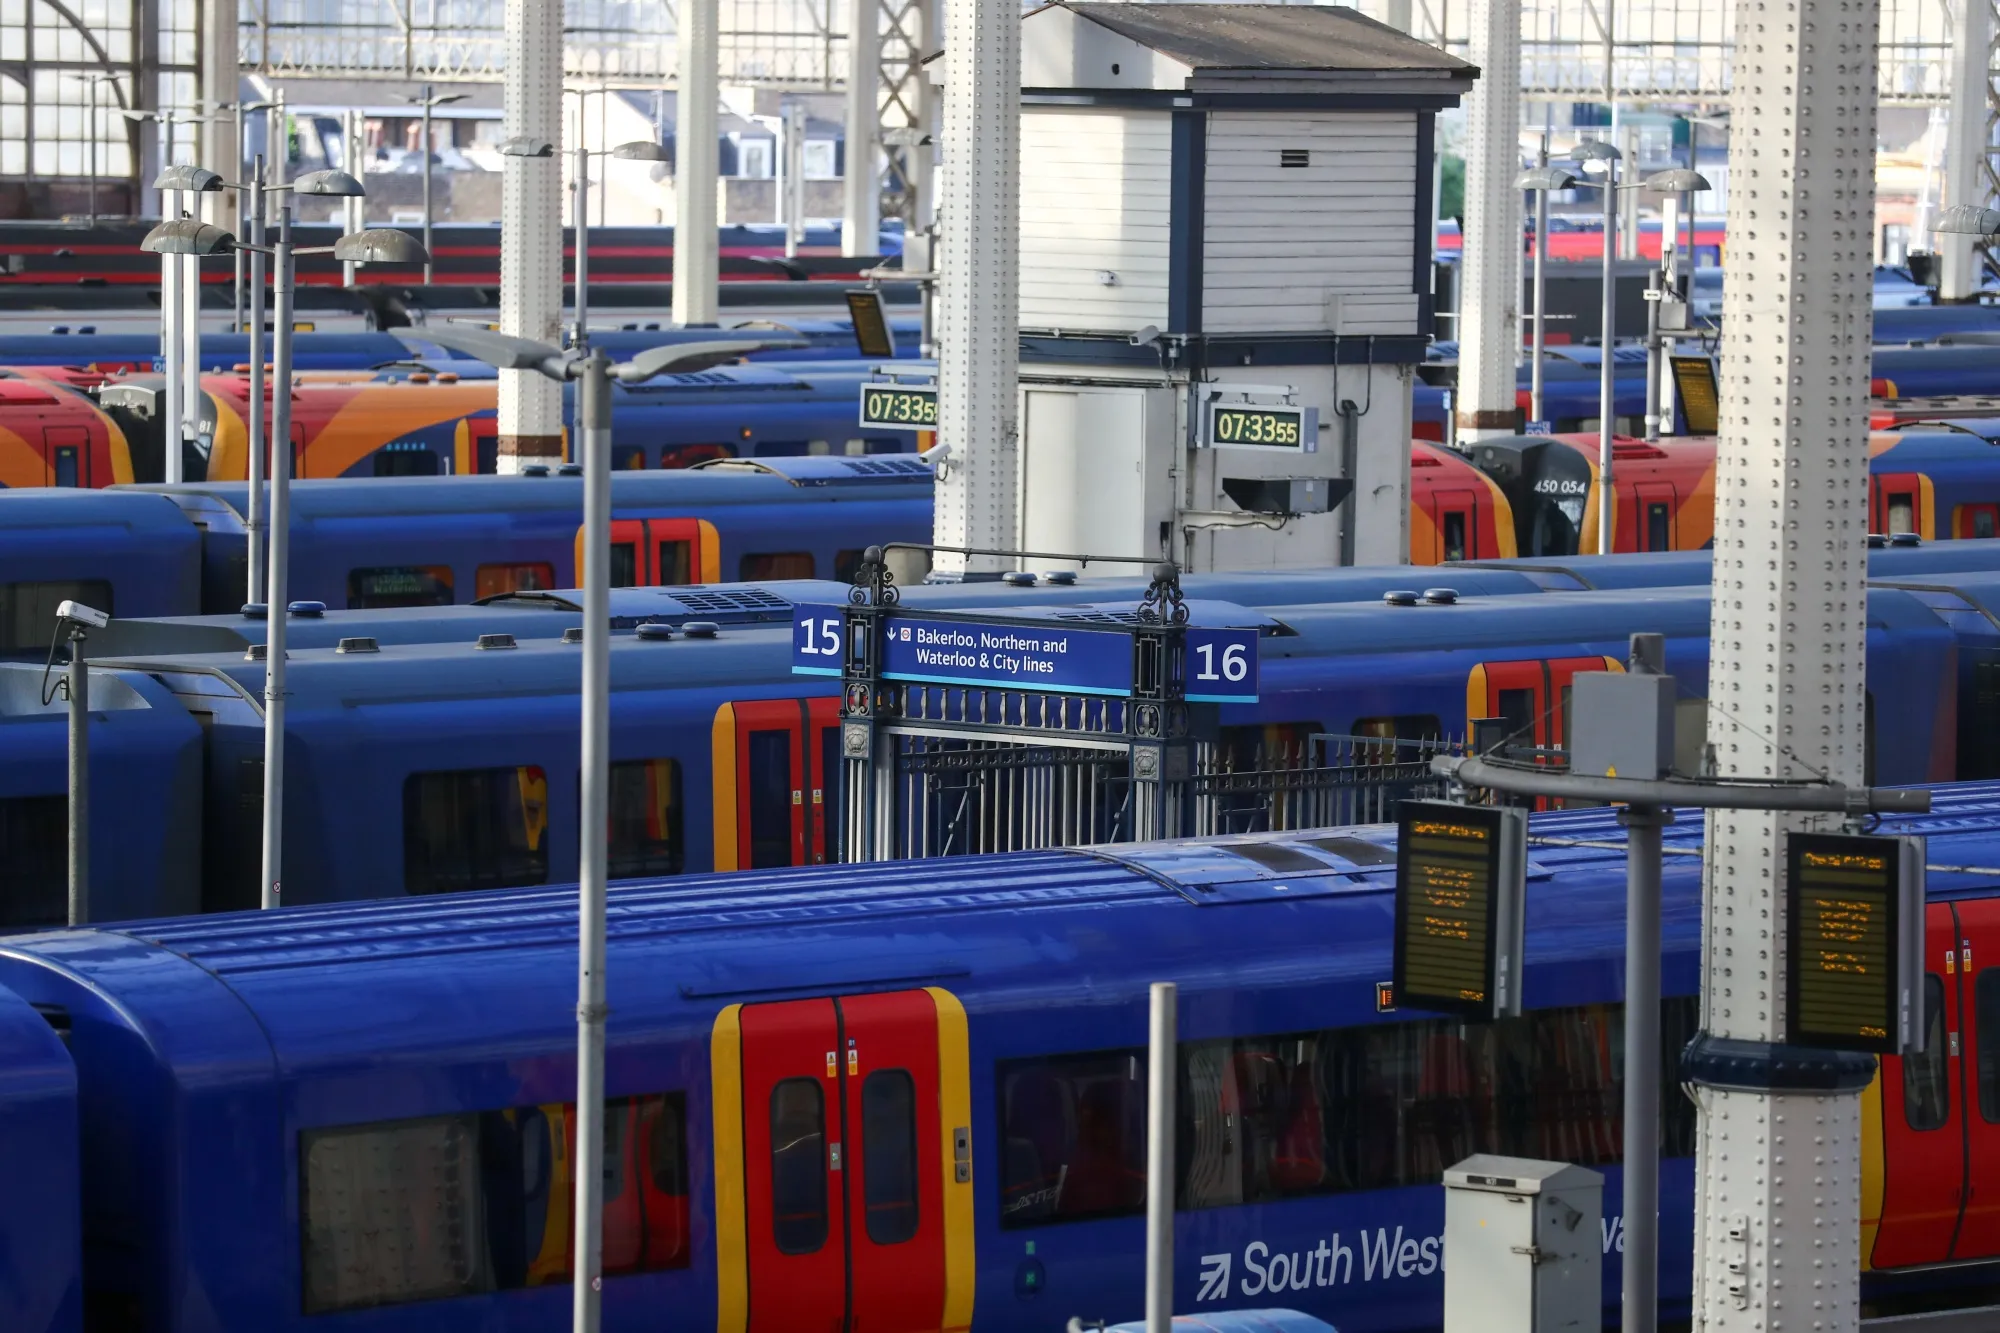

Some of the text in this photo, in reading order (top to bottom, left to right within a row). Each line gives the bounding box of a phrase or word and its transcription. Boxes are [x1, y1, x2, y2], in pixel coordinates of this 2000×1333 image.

[1534, 480, 1586, 494] 450 054
[801, 617, 840, 656] 15
[917, 628, 1067, 653] Bakerloo, Northern and
[916, 648, 1054, 674] Waterloo & City lines
[1196, 643, 1247, 682] 16
[1241, 1232, 1353, 1296] South
